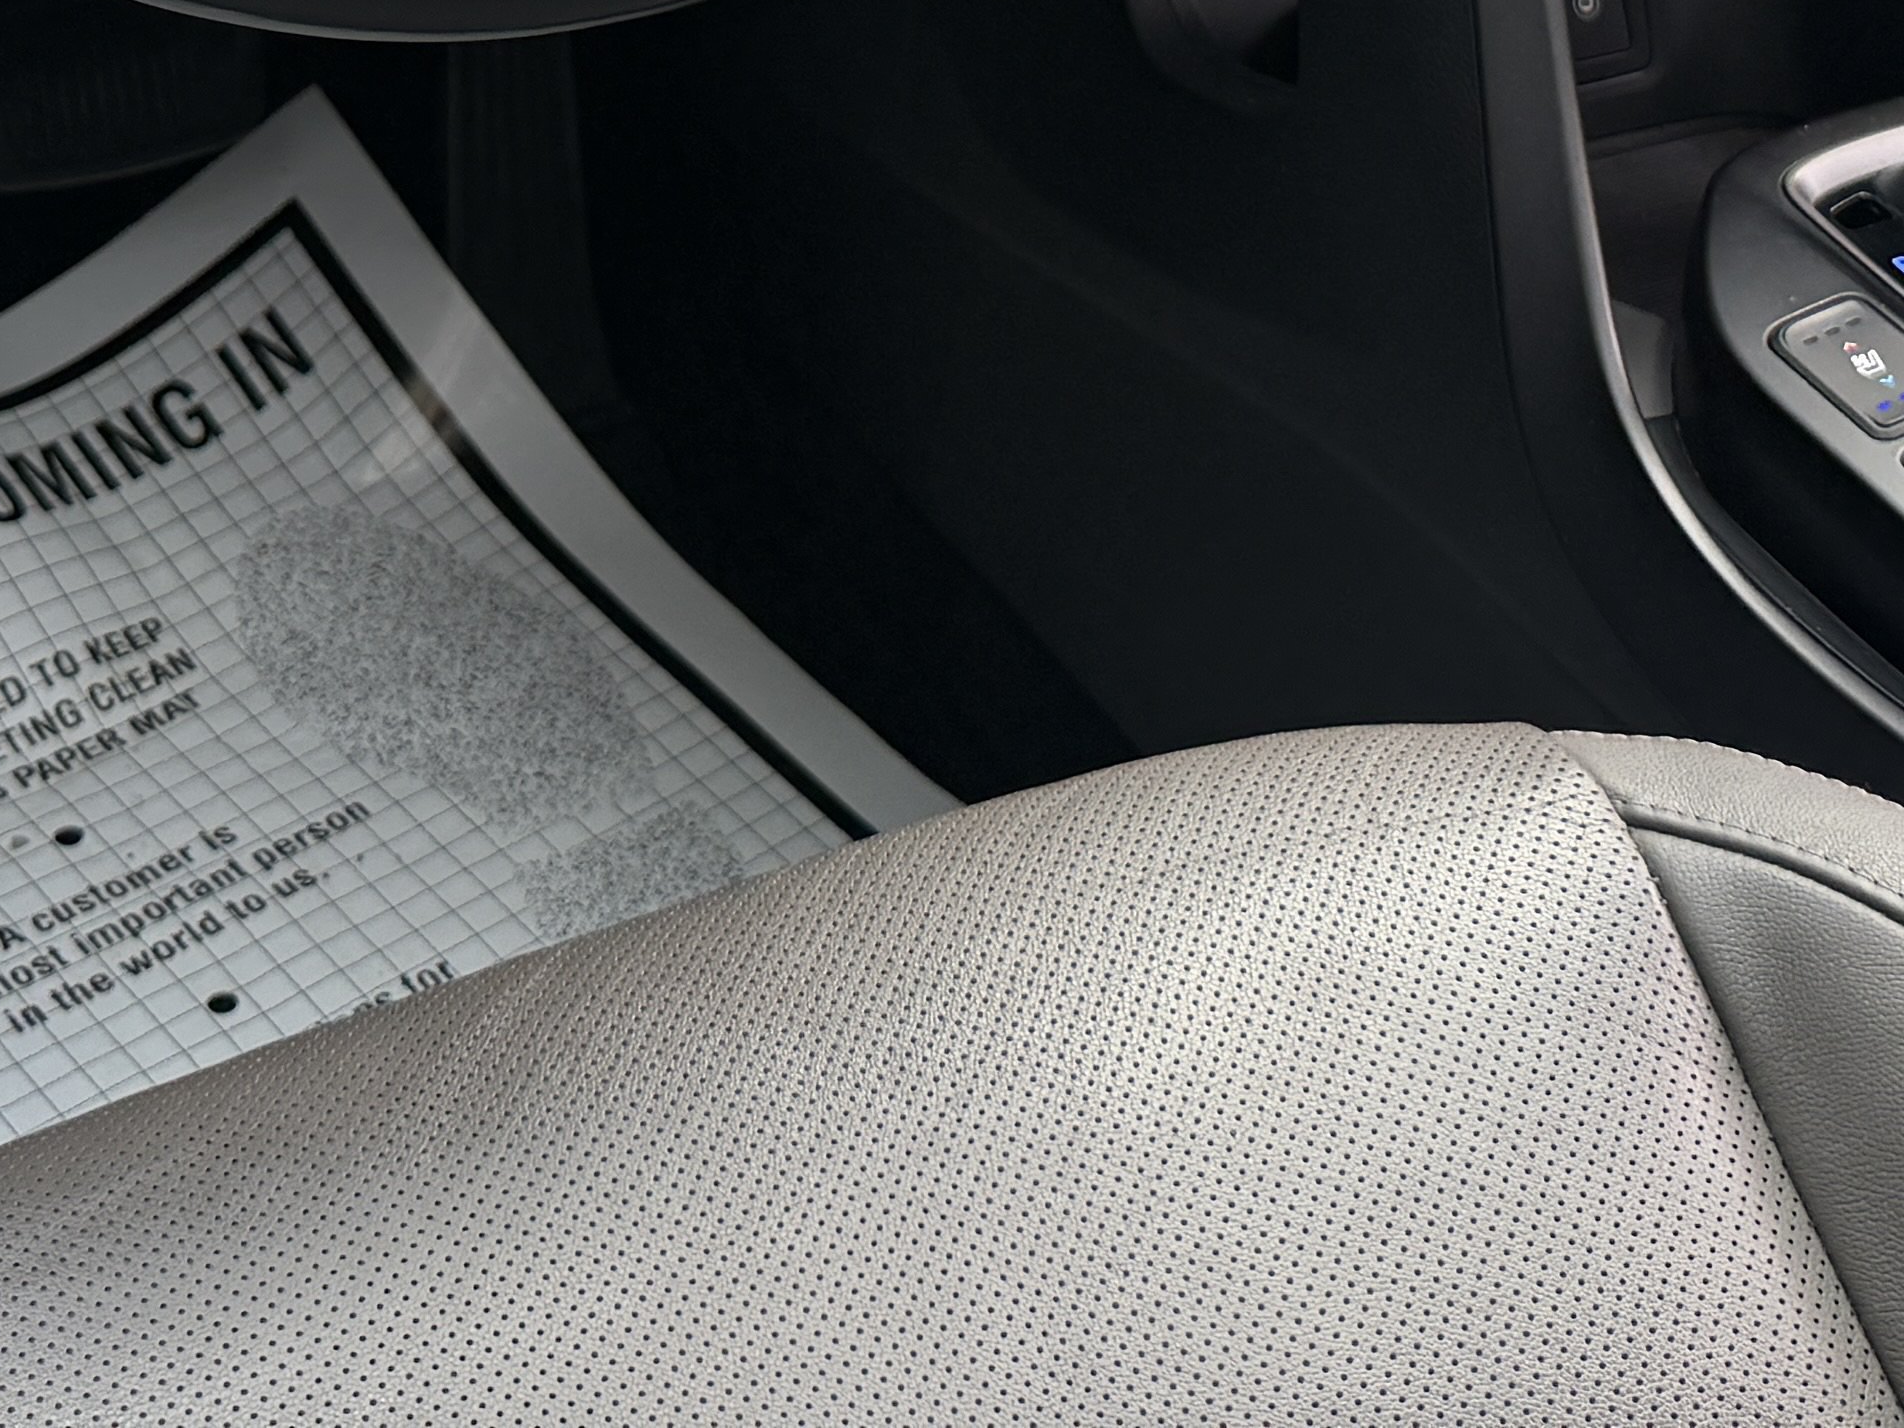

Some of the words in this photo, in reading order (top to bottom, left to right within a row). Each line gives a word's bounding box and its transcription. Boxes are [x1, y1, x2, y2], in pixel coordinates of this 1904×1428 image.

[217, 305, 319, 413] IN
[30, 648, 84, 690] TO
[81, 615, 166, 667] KEEP
[85, 645, 201, 713] CLEAN
[13, 732, 130, 791] PAPER
[128, 687, 205, 739] MAT
[29, 846, 196, 936] customer
[200, 822, 239, 859] is
[70, 859, 250, 963] important
[252, 796, 372, 876] person
[3, 1003, 42, 1036] in
[48, 963, 117, 1015] the
[120, 908, 225, 979] world
[225, 887, 269, 922] to
[272, 862, 332, 896] us.
[402, 959, 458, 998] for
